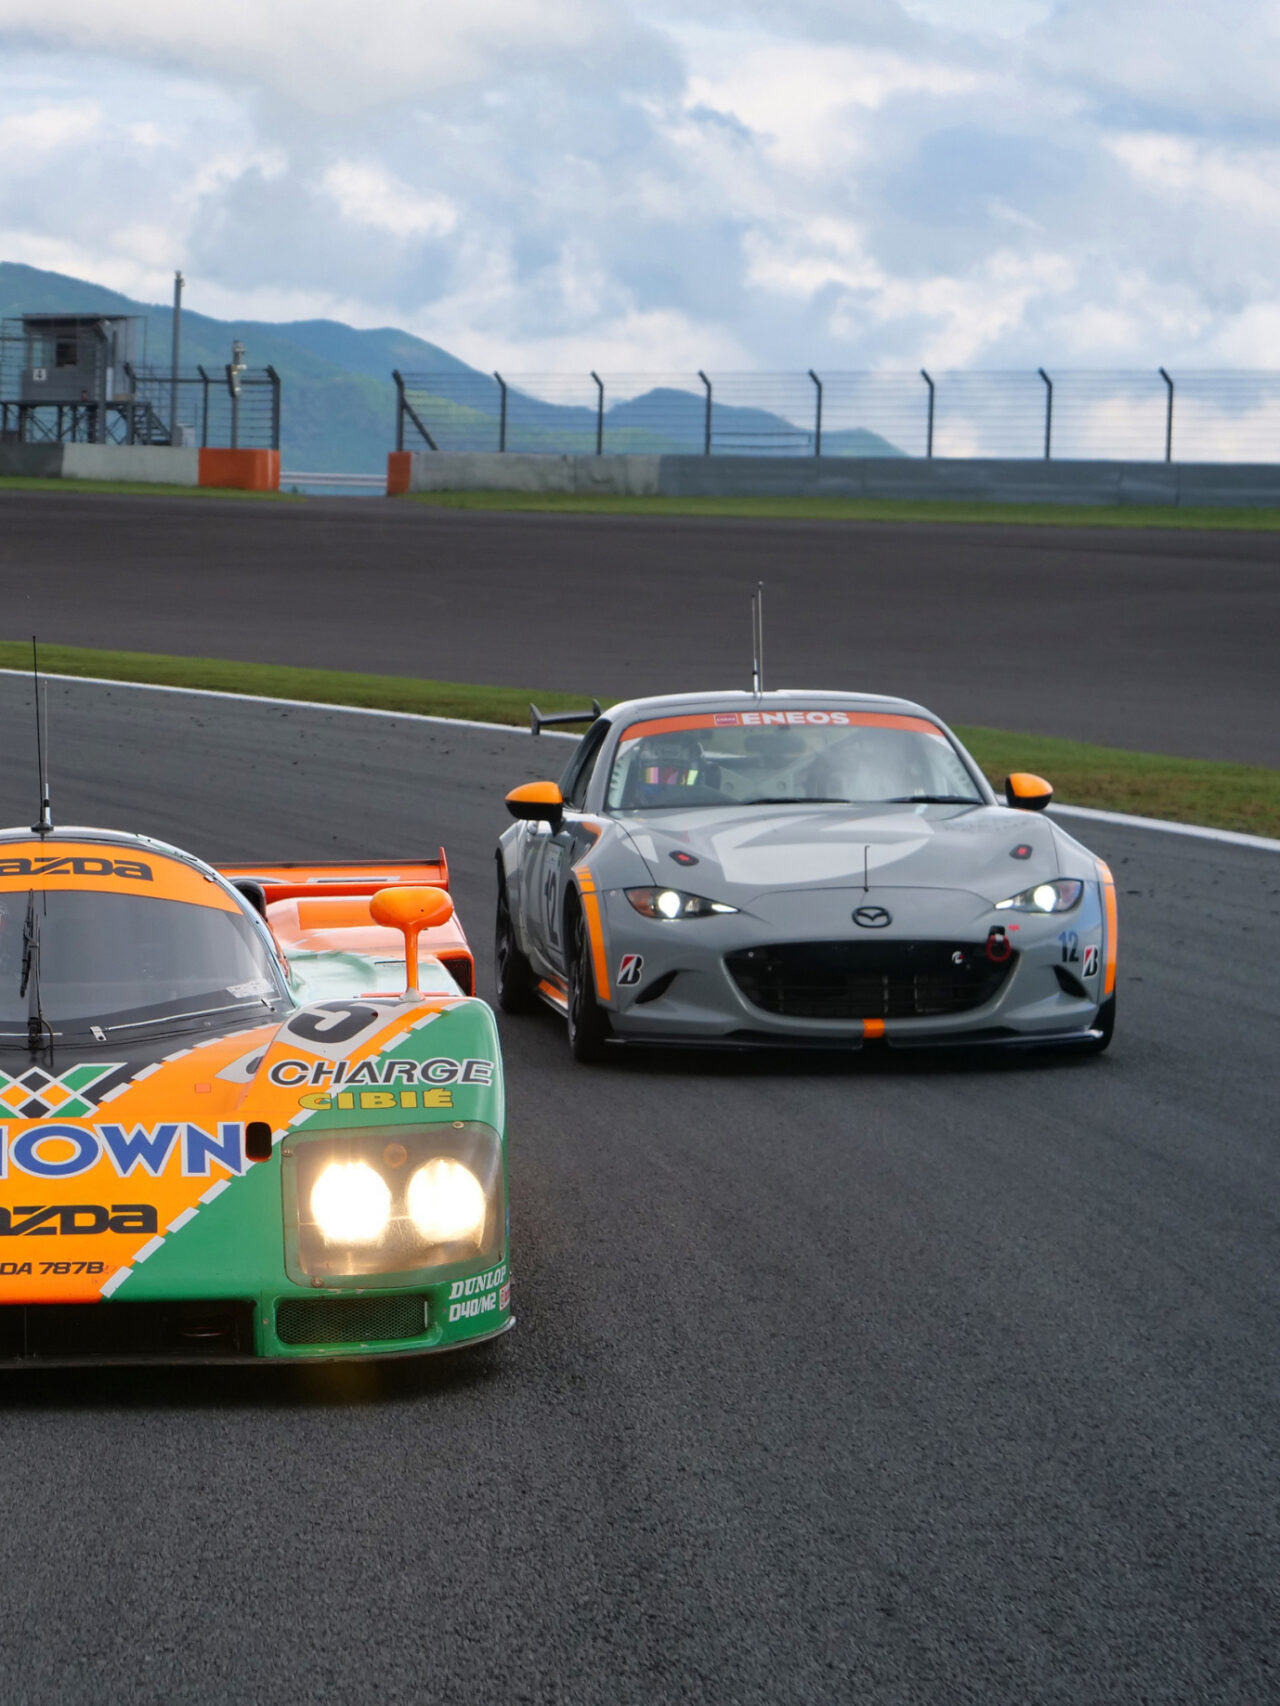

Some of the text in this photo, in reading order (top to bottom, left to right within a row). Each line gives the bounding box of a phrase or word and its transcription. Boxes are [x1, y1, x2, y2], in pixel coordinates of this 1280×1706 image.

[741, 712, 850, 725] ENEOS
[1058, 930, 1080, 963] 12
[268, 1057, 495, 1087] CHARGE
[298, 1087, 454, 1111] CIBIÉ
[39, 1261, 105, 1275] 787B
[448, 1264, 507, 1300] DUNLOP
